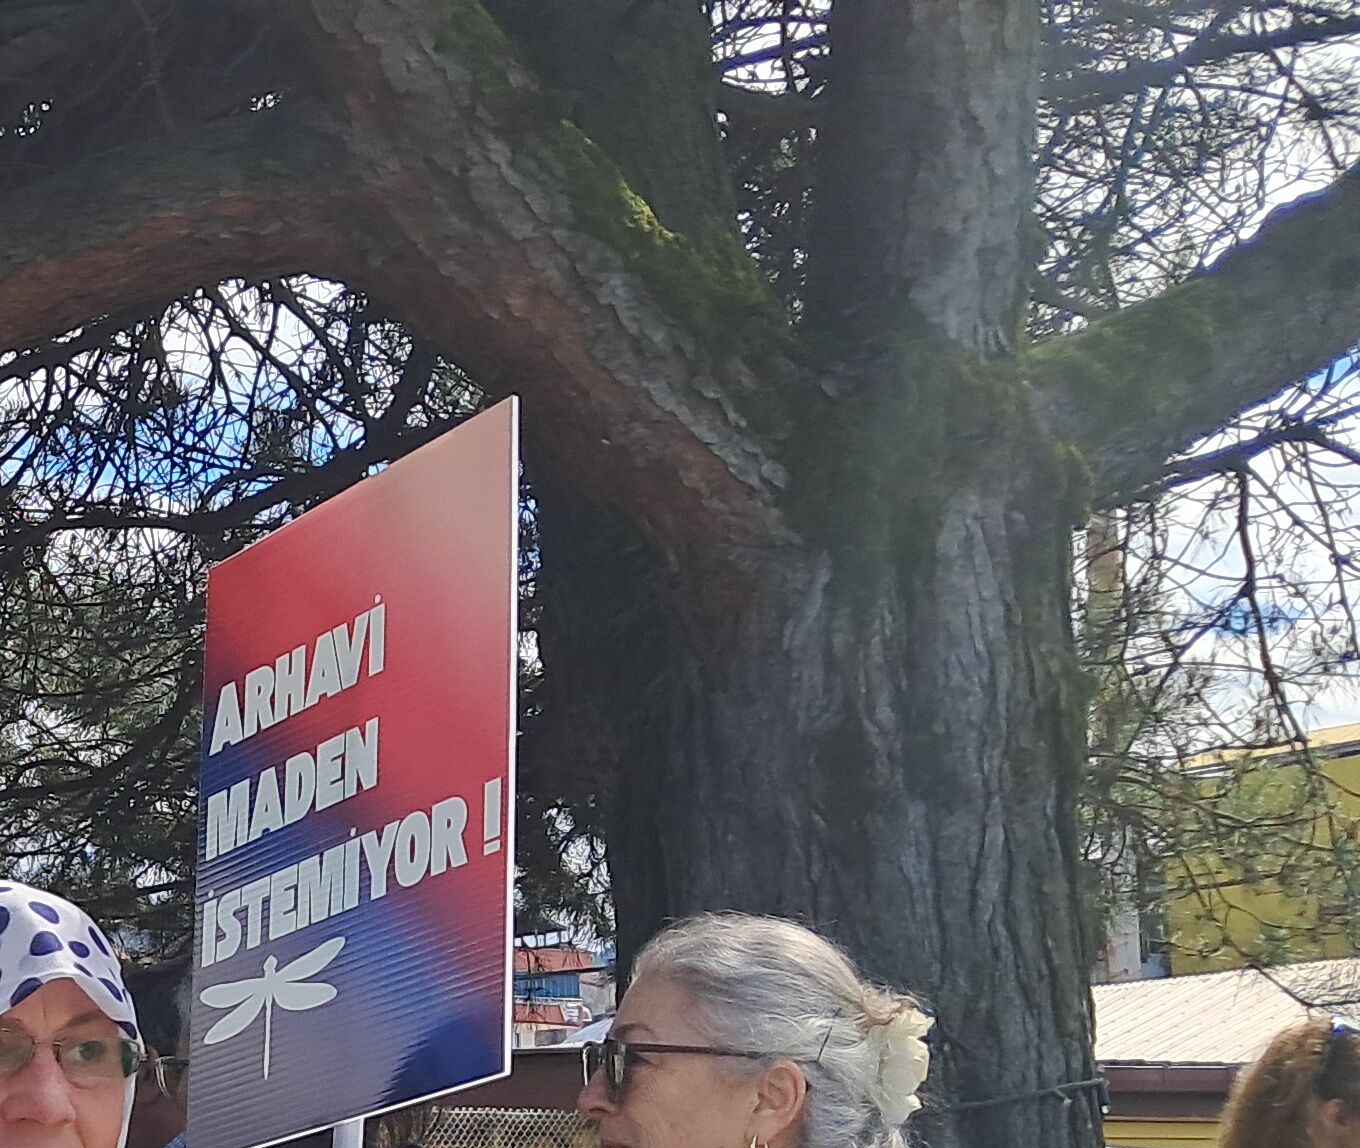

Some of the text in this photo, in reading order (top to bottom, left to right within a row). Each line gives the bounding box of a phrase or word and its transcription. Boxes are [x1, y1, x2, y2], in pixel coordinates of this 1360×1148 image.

[209, 593, 386, 757] ARHAVİ
[205, 717, 379, 861] MADEN
[201, 796, 469, 968] İSTEMİYOR
